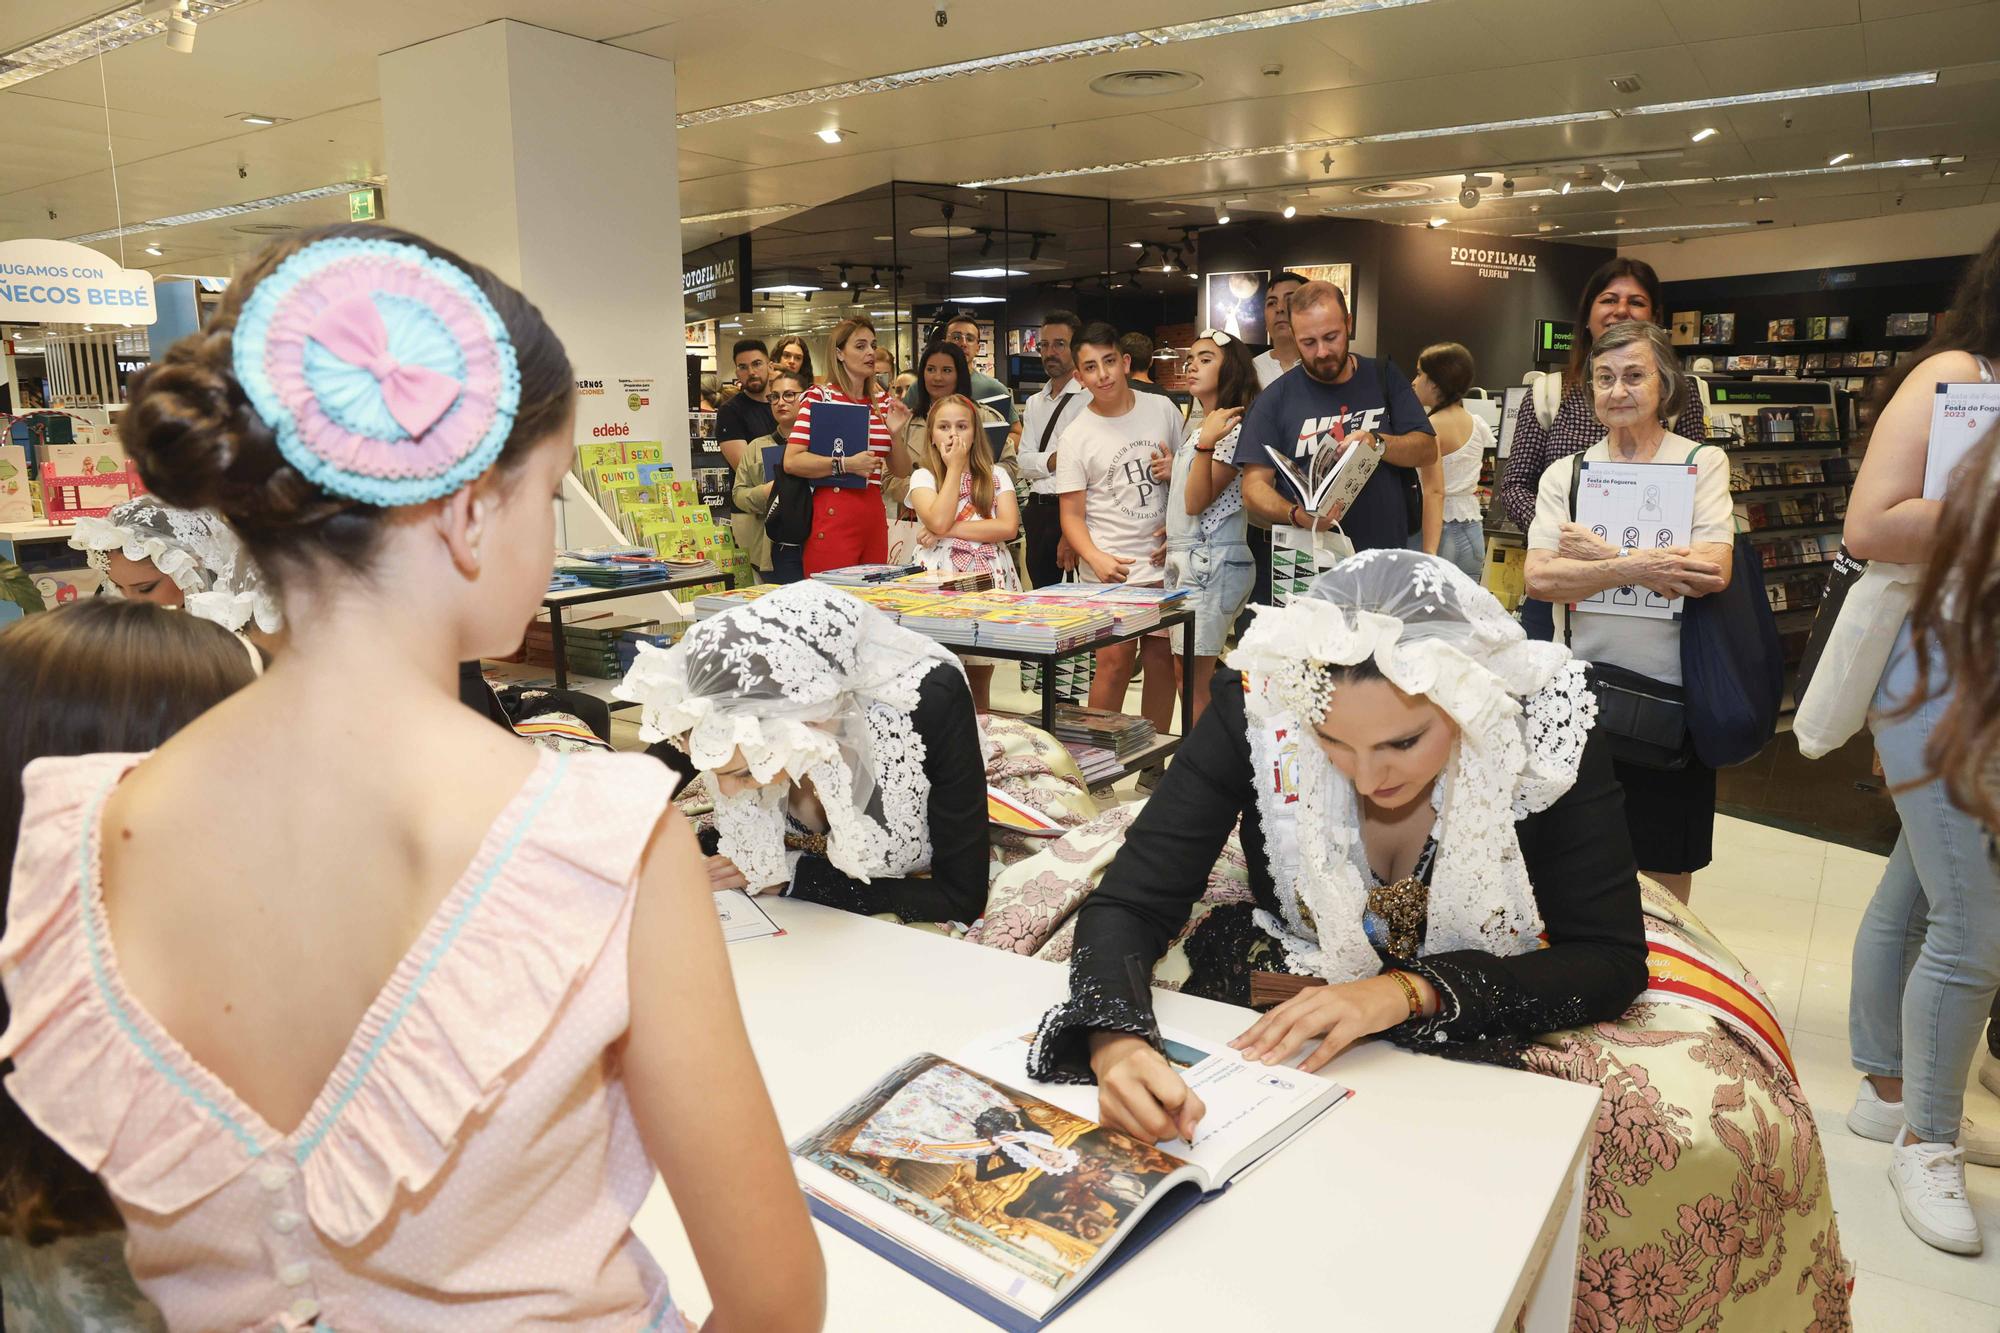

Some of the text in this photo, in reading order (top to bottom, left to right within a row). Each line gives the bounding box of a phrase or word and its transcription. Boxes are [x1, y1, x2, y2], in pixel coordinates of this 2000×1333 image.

[1451, 247, 1536, 267] FOTOFILMAX
[72, 268, 104, 279] CON
[1479, 268, 1510, 279] FUJIFILM
[87, 286, 149, 307] BEBÉ
[593, 422, 629, 437] edebé
[631, 449, 660, 460] SEXTO
[1113, 447, 1128, 464] CLUB
[601, 471, 635, 484] QUINTO
[683, 512, 709, 524] la ESO
[704, 533, 730, 545] la ESO
